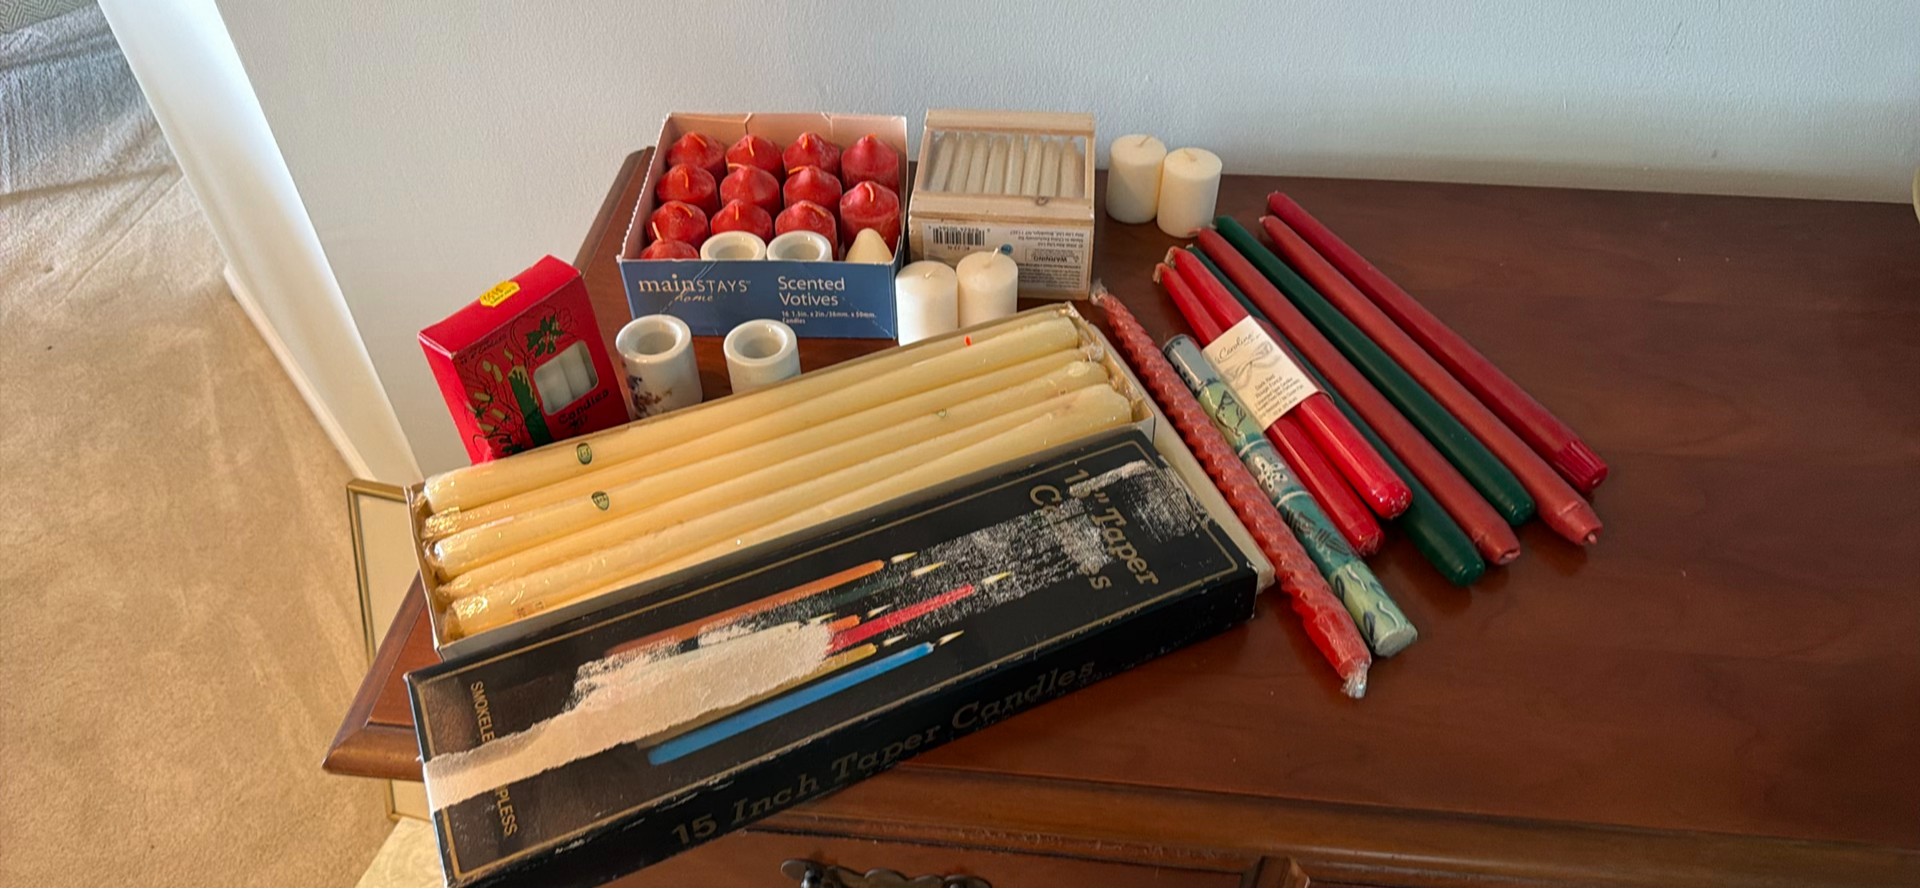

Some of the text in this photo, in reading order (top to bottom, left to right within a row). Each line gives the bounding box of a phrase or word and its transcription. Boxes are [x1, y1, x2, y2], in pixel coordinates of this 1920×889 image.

[778, 276, 845, 291] Scented
[1033, 255, 1067, 263] WARNING
[779, 292, 839, 306] Votives
[1029, 484, 1112, 590] Caes
[1091, 507, 1159, 584] Taper
[471, 680, 497, 743] SMOKELE
[672, 661, 1096, 845] 15 Inch Taper Candles
